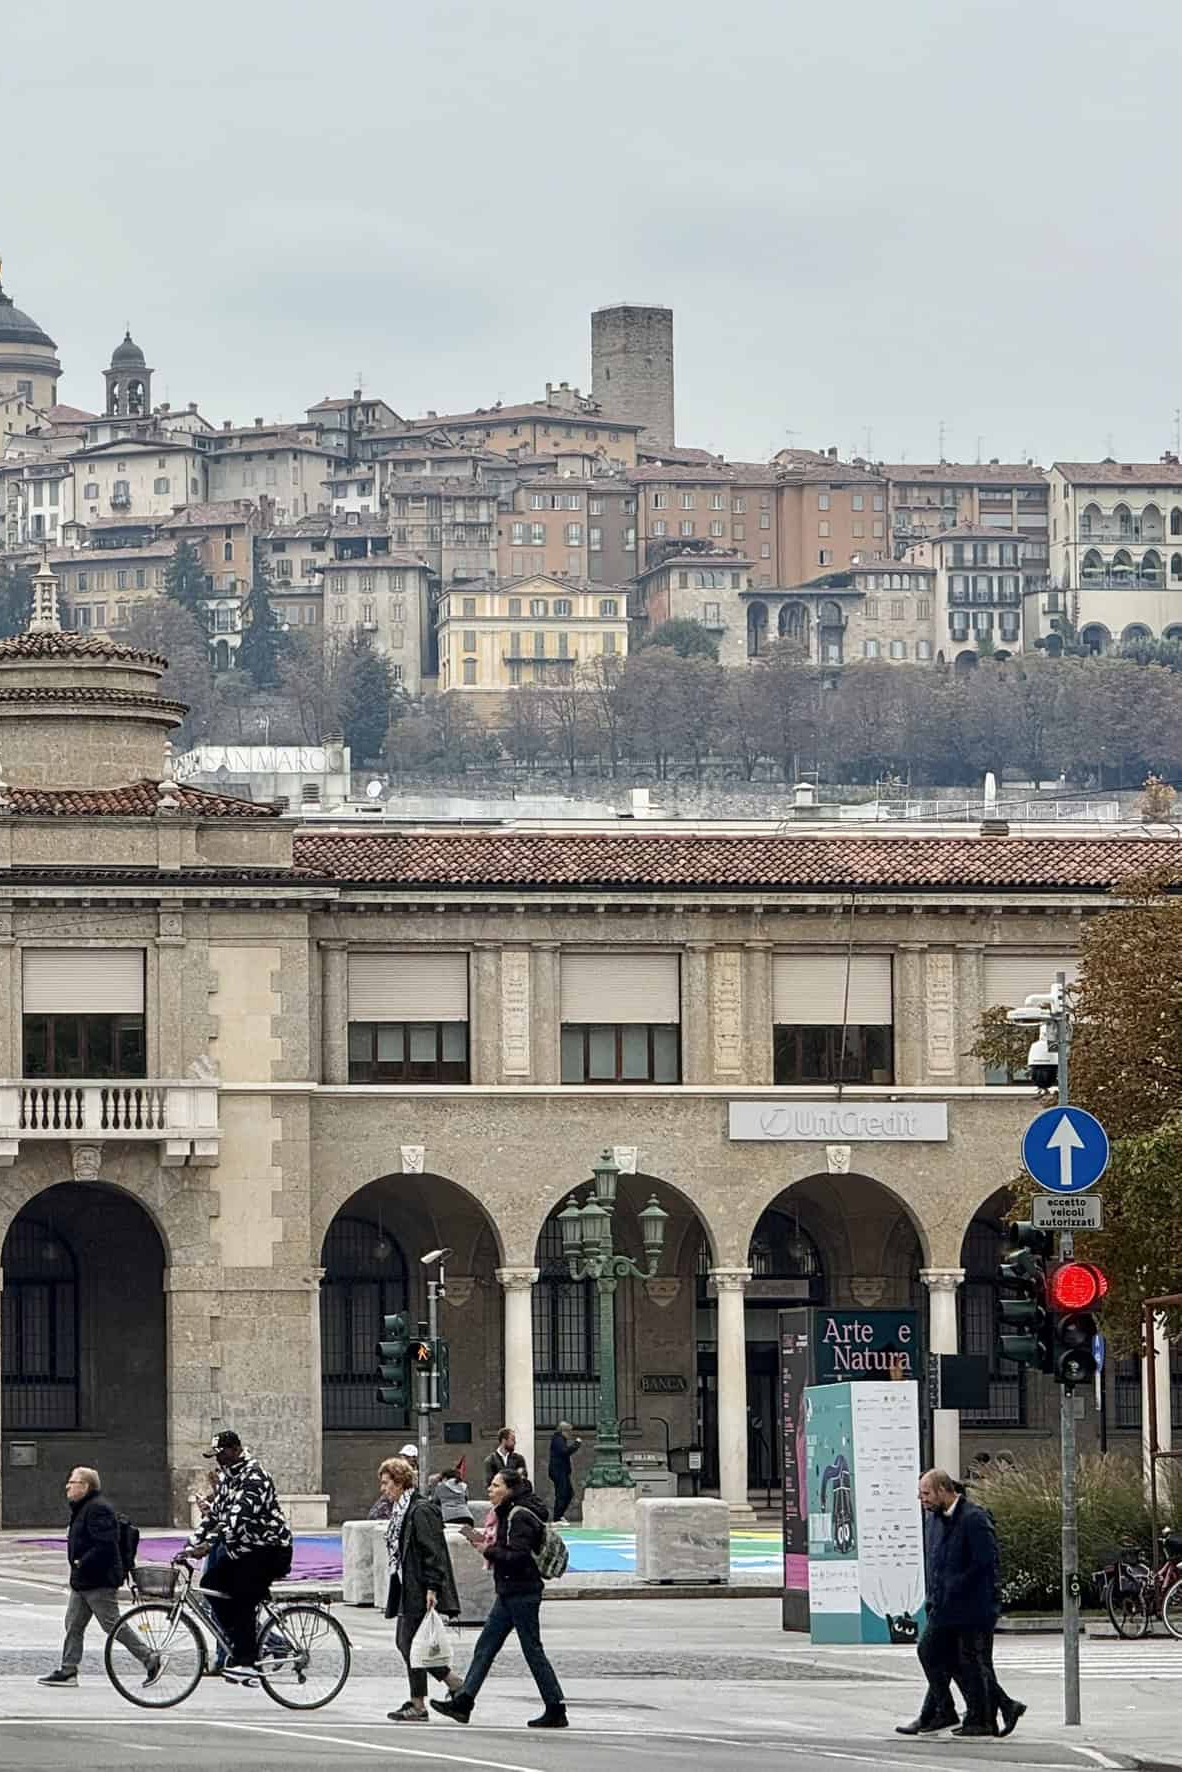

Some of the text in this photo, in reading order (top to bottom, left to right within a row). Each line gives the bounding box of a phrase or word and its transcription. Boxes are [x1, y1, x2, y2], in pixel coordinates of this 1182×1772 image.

[794, 1110, 917, 1137] UniCredit
[1047, 1198, 1087, 1206] eccetto
[1050, 1207, 1085, 1216] veicoli
[1039, 1217, 1095, 1227] autorizzati
[822, 1318, 912, 1344] Arte e
[833, 1345, 912, 1371] Natura
[641, 1376, 686, 1393] BANCA
